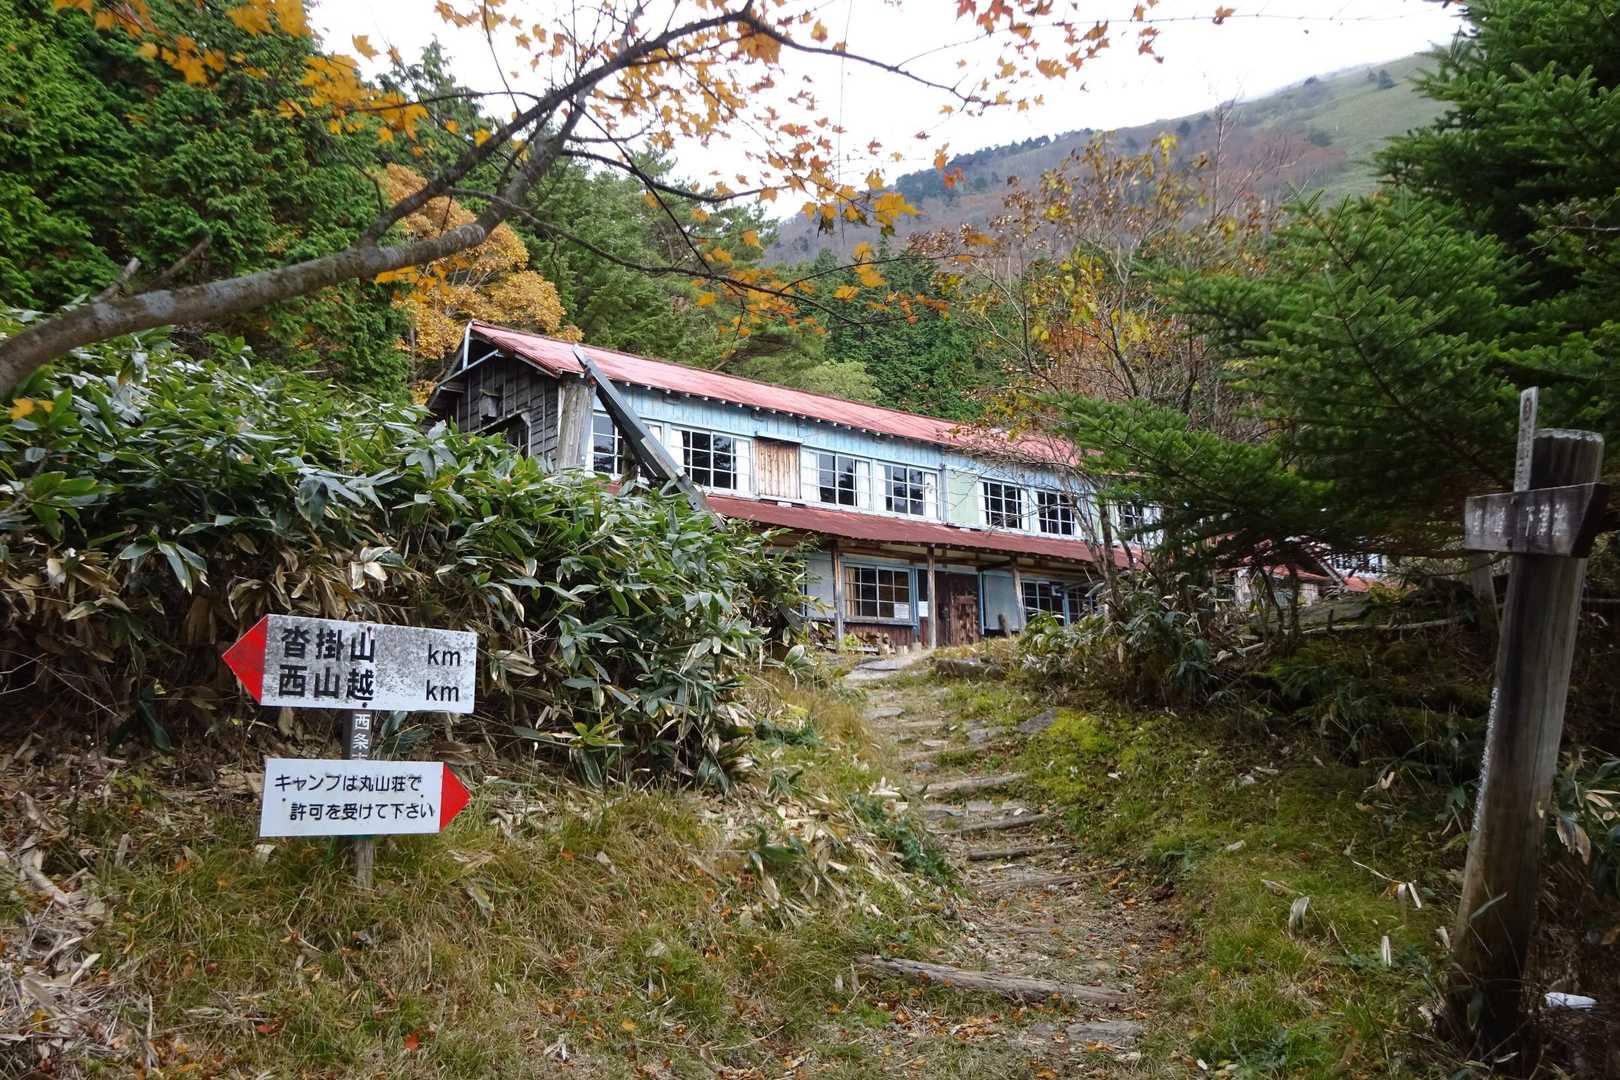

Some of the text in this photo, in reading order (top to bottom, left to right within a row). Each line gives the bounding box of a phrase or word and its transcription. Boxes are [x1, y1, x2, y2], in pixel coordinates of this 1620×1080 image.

[281, 626, 461, 667] 沓掛山 km
[279, 664, 460, 702] 西山越 km
[290, 802, 434, 821] 許可を受けて下さい
